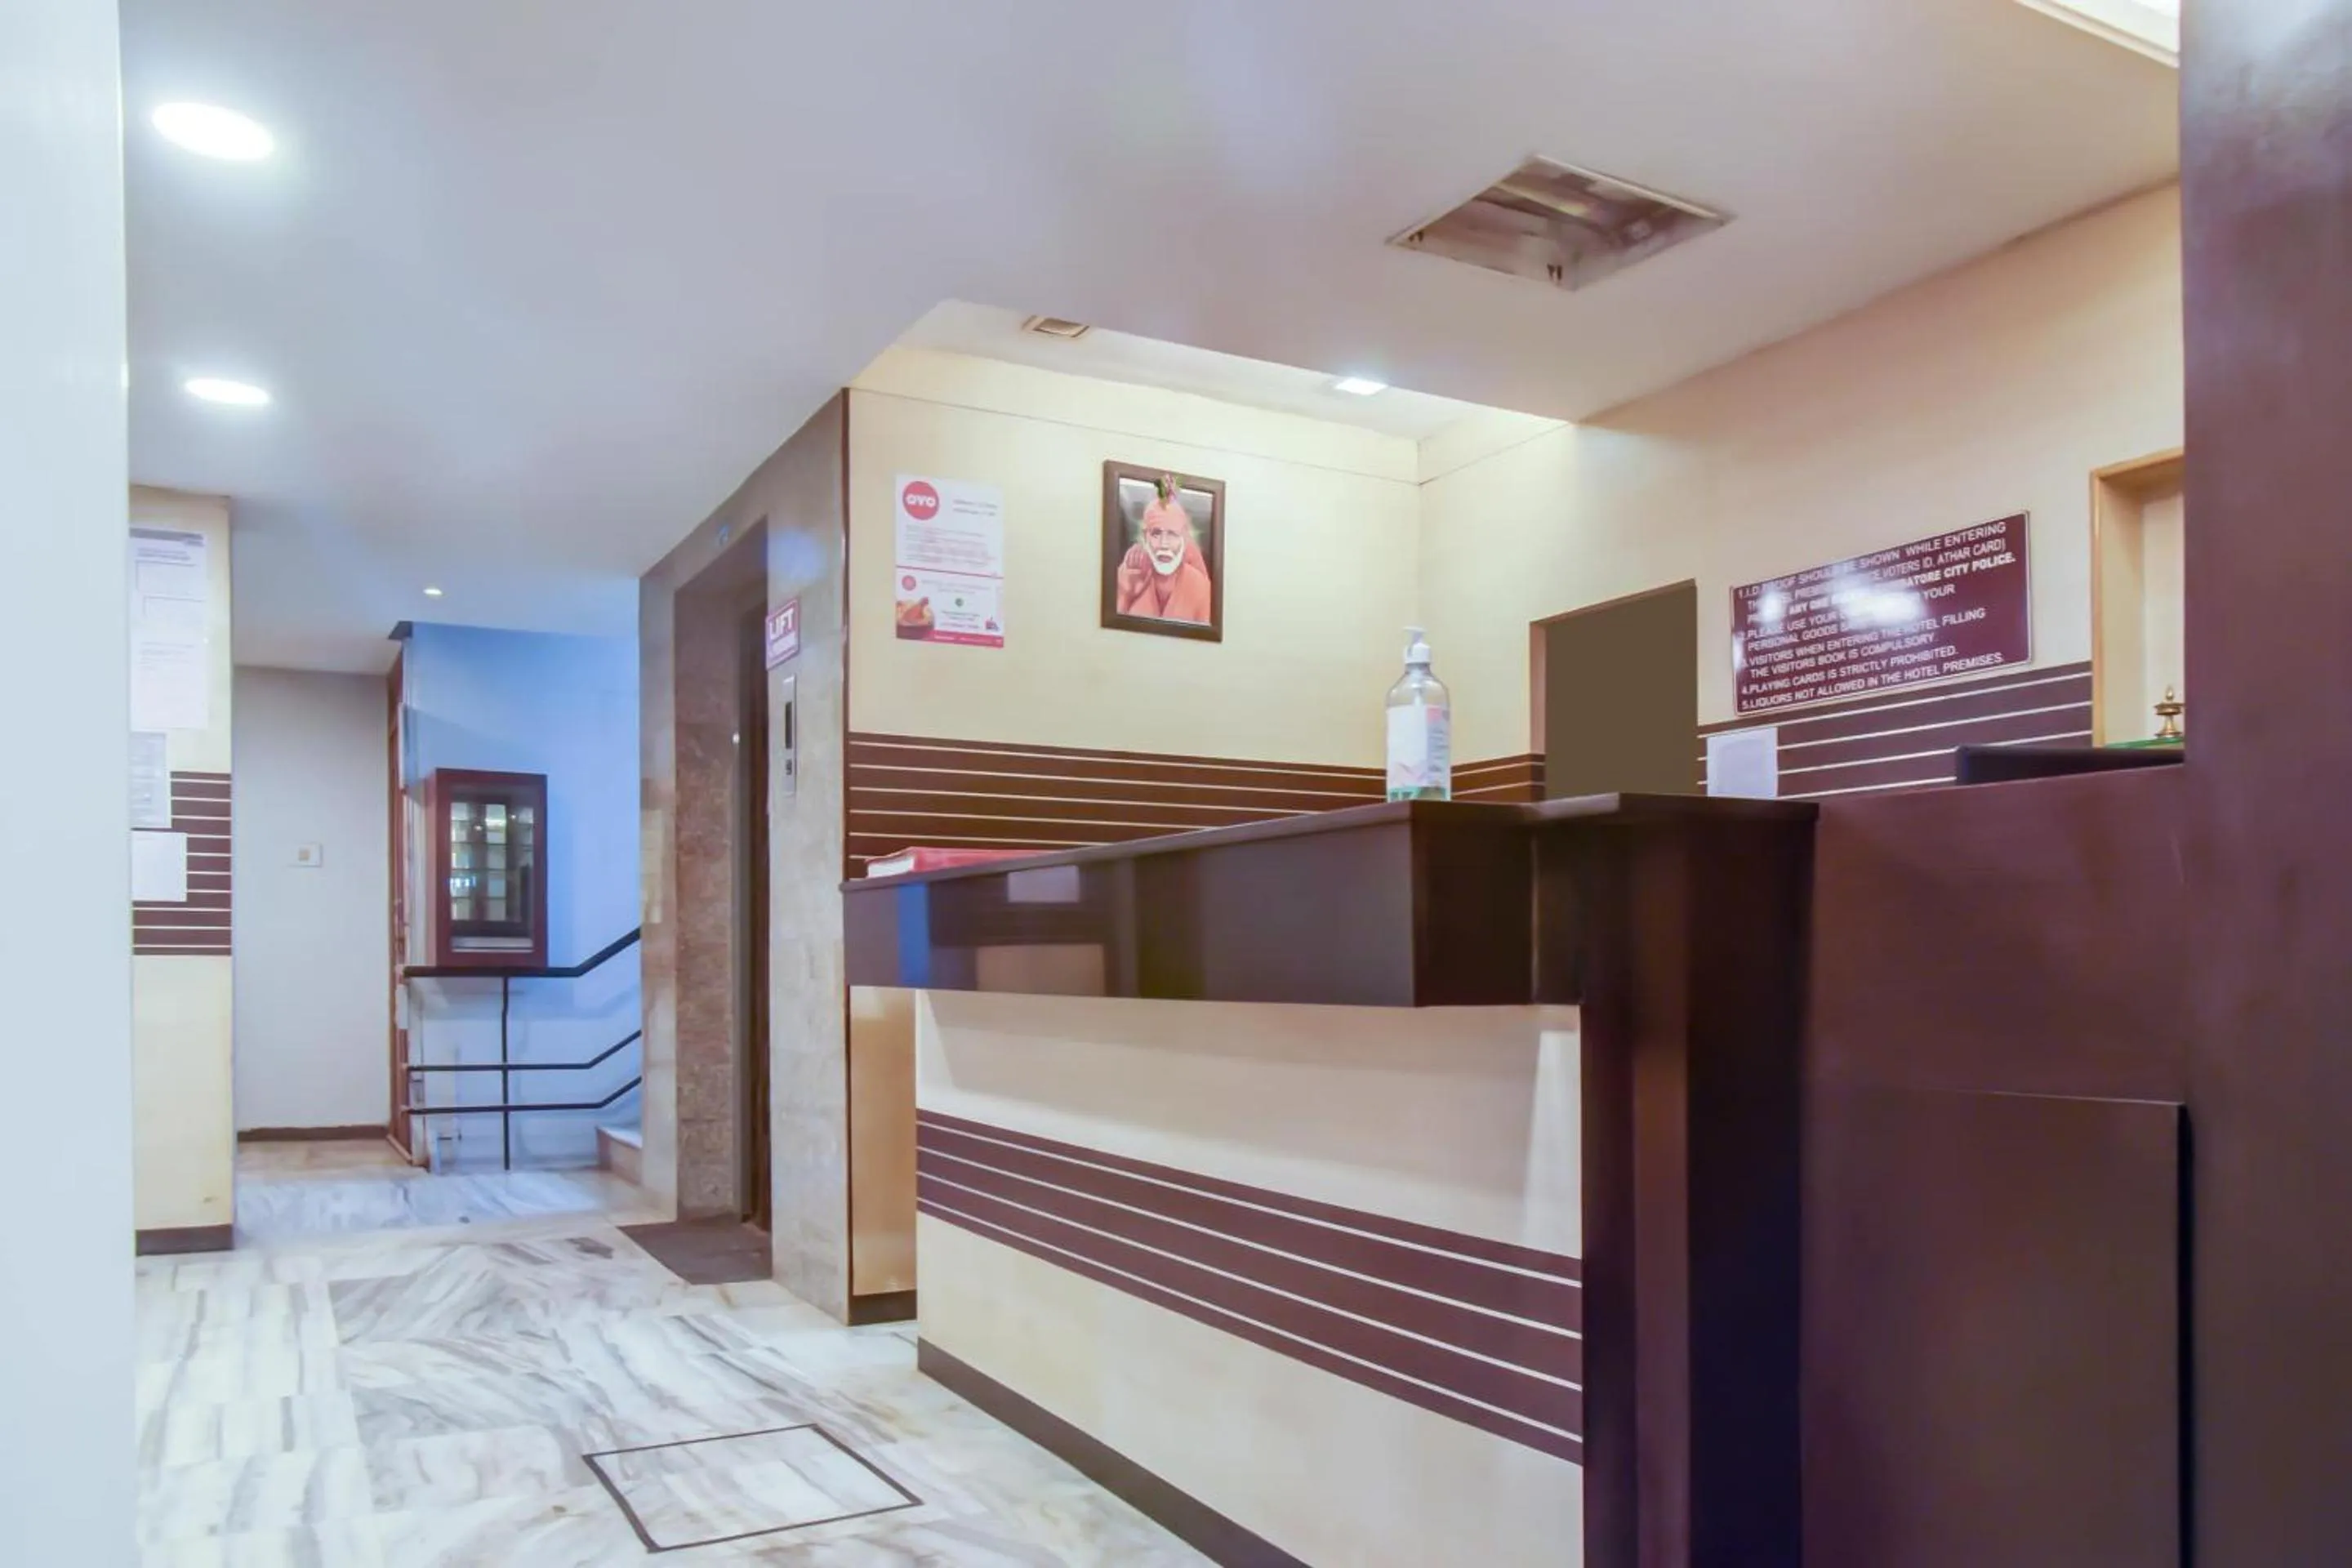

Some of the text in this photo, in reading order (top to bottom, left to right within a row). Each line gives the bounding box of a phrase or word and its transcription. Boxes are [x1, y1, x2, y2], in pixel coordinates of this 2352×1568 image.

[1798, 564, 1842, 583] SHOUL
[1858, 549, 1900, 568] SHOWN
[1904, 538, 1940, 556] WHILE
[1944, 521, 2006, 546] ENTERING
[1936, 546, 1971, 565] ATHAR
[1972, 537, 2005, 556] CARD)
[1944, 562, 1969, 577] CITY
[1971, 550, 2016, 571] POLICE.
[1786, 617, 1806, 630] USE
[1809, 611, 1838, 626] YOUR
[1923, 583, 1956, 599] YOUR
[768, 608, 795, 640] LIFT
[1748, 623, 1838, 652] PERSONAL GOODS
[1795, 643, 1824, 657] WHEN
[1826, 630, 1878, 651] ENTERING
[1942, 608, 1985, 626] FILLING
[1750, 666, 1769, 679] THE
[1771, 657, 1815, 674] VISITORS
[1817, 651, 1846, 665] BOOK
[1848, 648, 1858, 658] IS
[1792, 670, 1825, 685] CARDS
[1827, 668, 1837, 679] IS
[1839, 658, 1887, 676] STRICTLY
[1890, 644, 1958, 666] PROHIBITED.
[1795, 688, 1816, 700] NOT
[1816, 679, 1864, 696] ALLOWED
[1867, 676, 1878, 687] IN
[1881, 671, 1901, 684] THE
[1904, 664, 1940, 679] HOTEL
